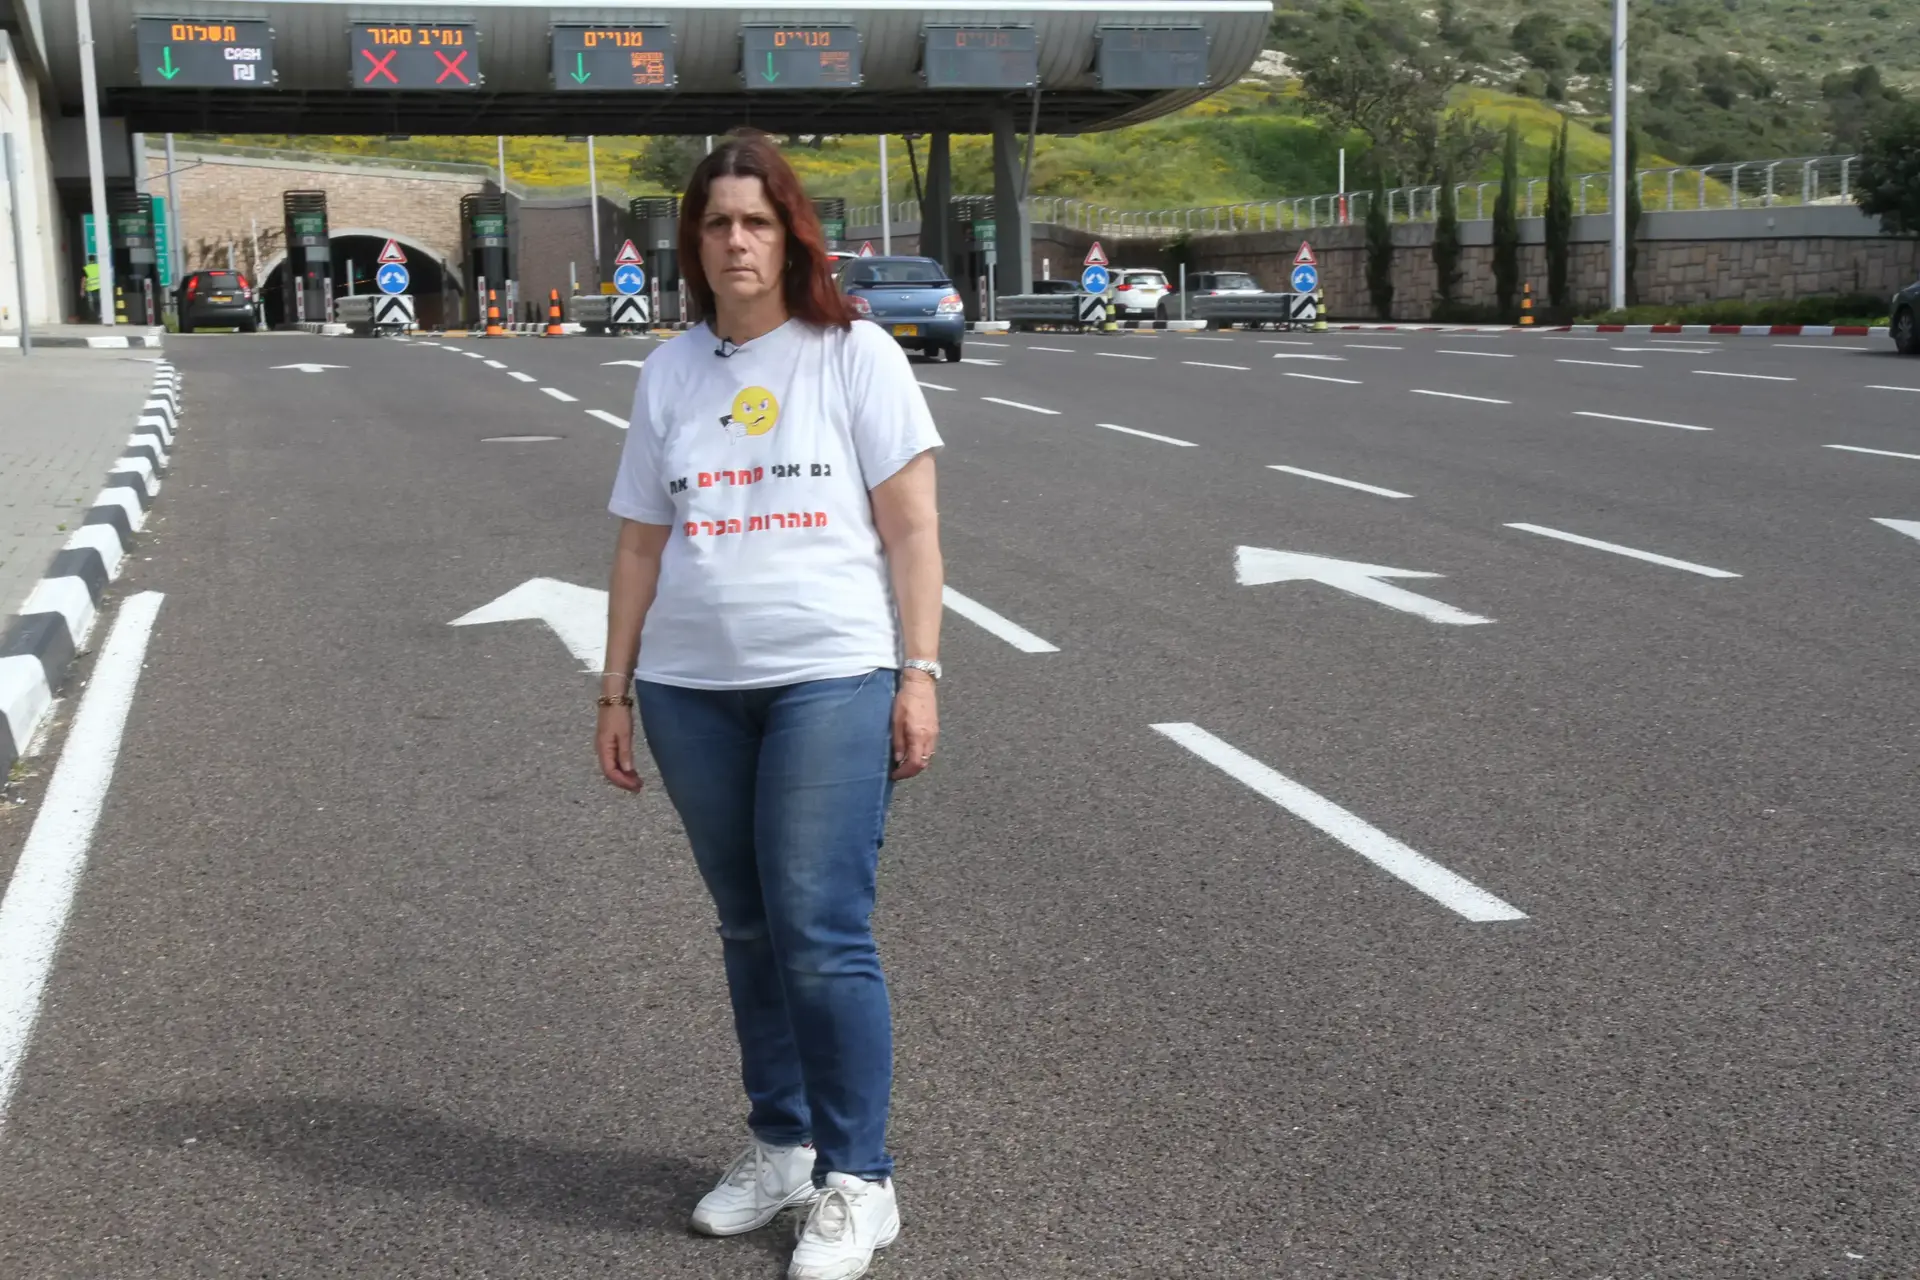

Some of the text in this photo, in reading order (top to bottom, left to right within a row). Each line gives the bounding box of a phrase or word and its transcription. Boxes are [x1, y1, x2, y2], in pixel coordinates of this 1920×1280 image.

[171, 24, 236, 41] תשלום
[367, 28, 464, 45] נתיב סגור
[584, 31, 643, 46] מנויים
[774, 31, 831, 46] מנויים
[224, 47, 262, 60] CASH
[697, 466, 764, 488] מחרים
[771, 463, 802, 478] אני
[810, 463, 832, 477] גם
[683, 511, 828, 537] מנהרות הכרמ
